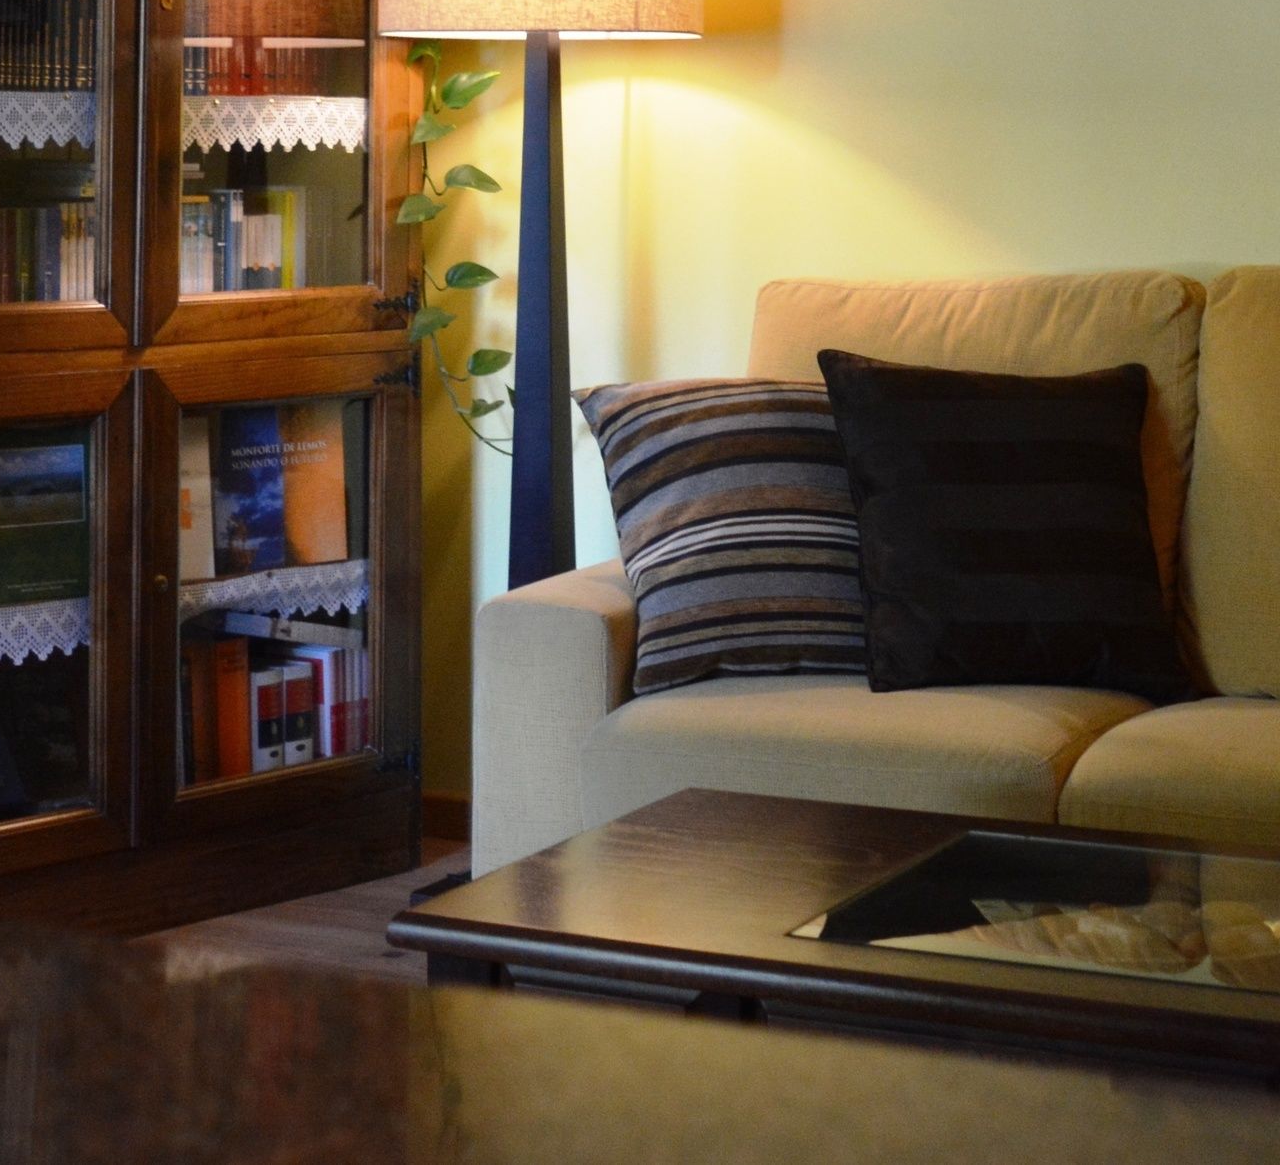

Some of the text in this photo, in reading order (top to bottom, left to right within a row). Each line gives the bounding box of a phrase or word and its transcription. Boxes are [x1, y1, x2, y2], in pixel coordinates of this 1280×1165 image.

[231, 440, 327, 457] MONFORTE DE LEMOS
